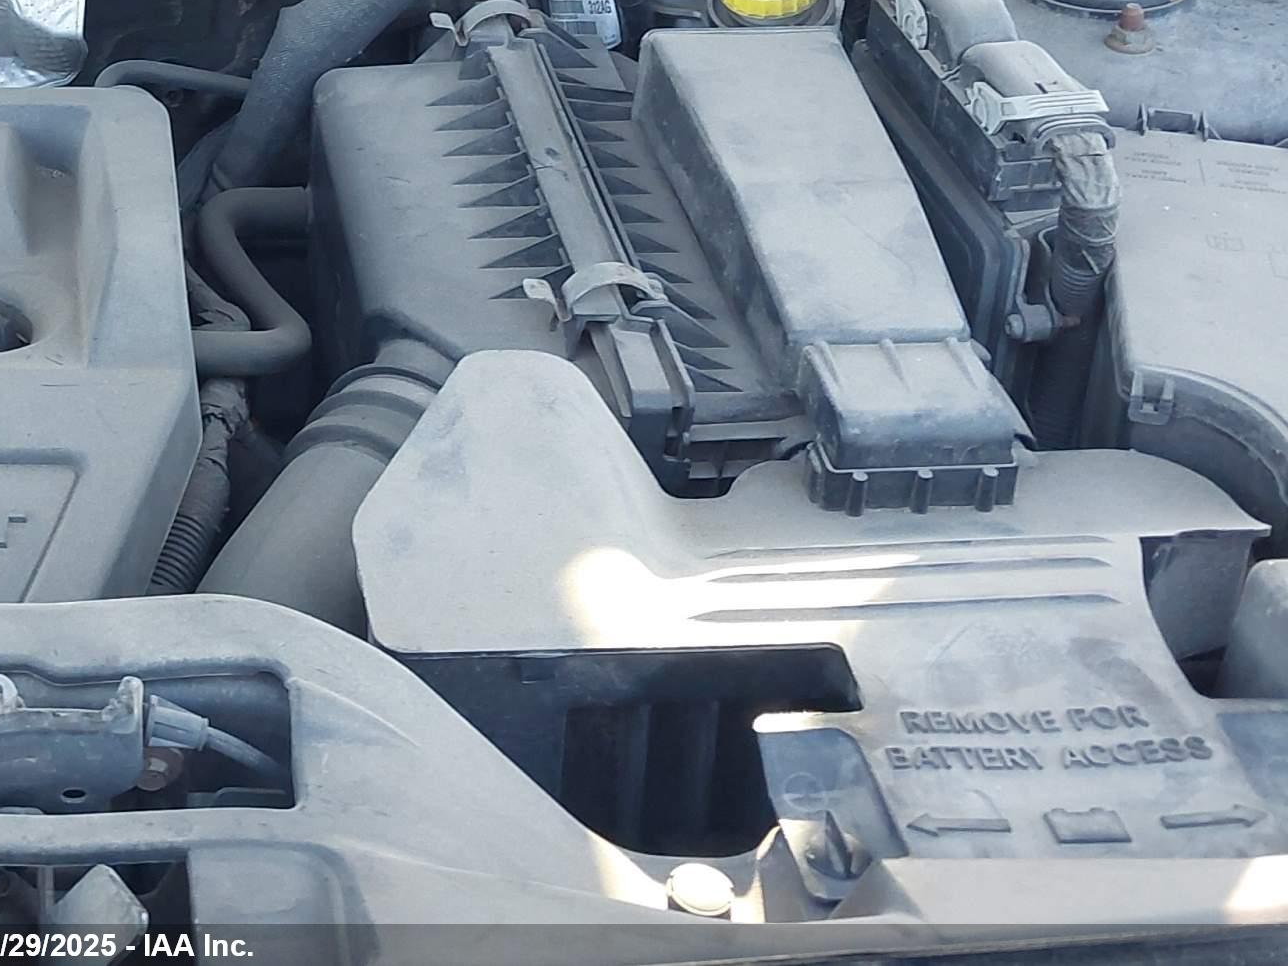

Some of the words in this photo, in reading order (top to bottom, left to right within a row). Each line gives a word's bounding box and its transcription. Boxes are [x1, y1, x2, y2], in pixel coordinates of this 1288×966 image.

[899, 710, 1061, 735] REMOVE
[1066, 705, 1150, 732] FOR
[885, 745, 1044, 772] BATTERY
[1063, 736, 1213, 770] ACCESS
